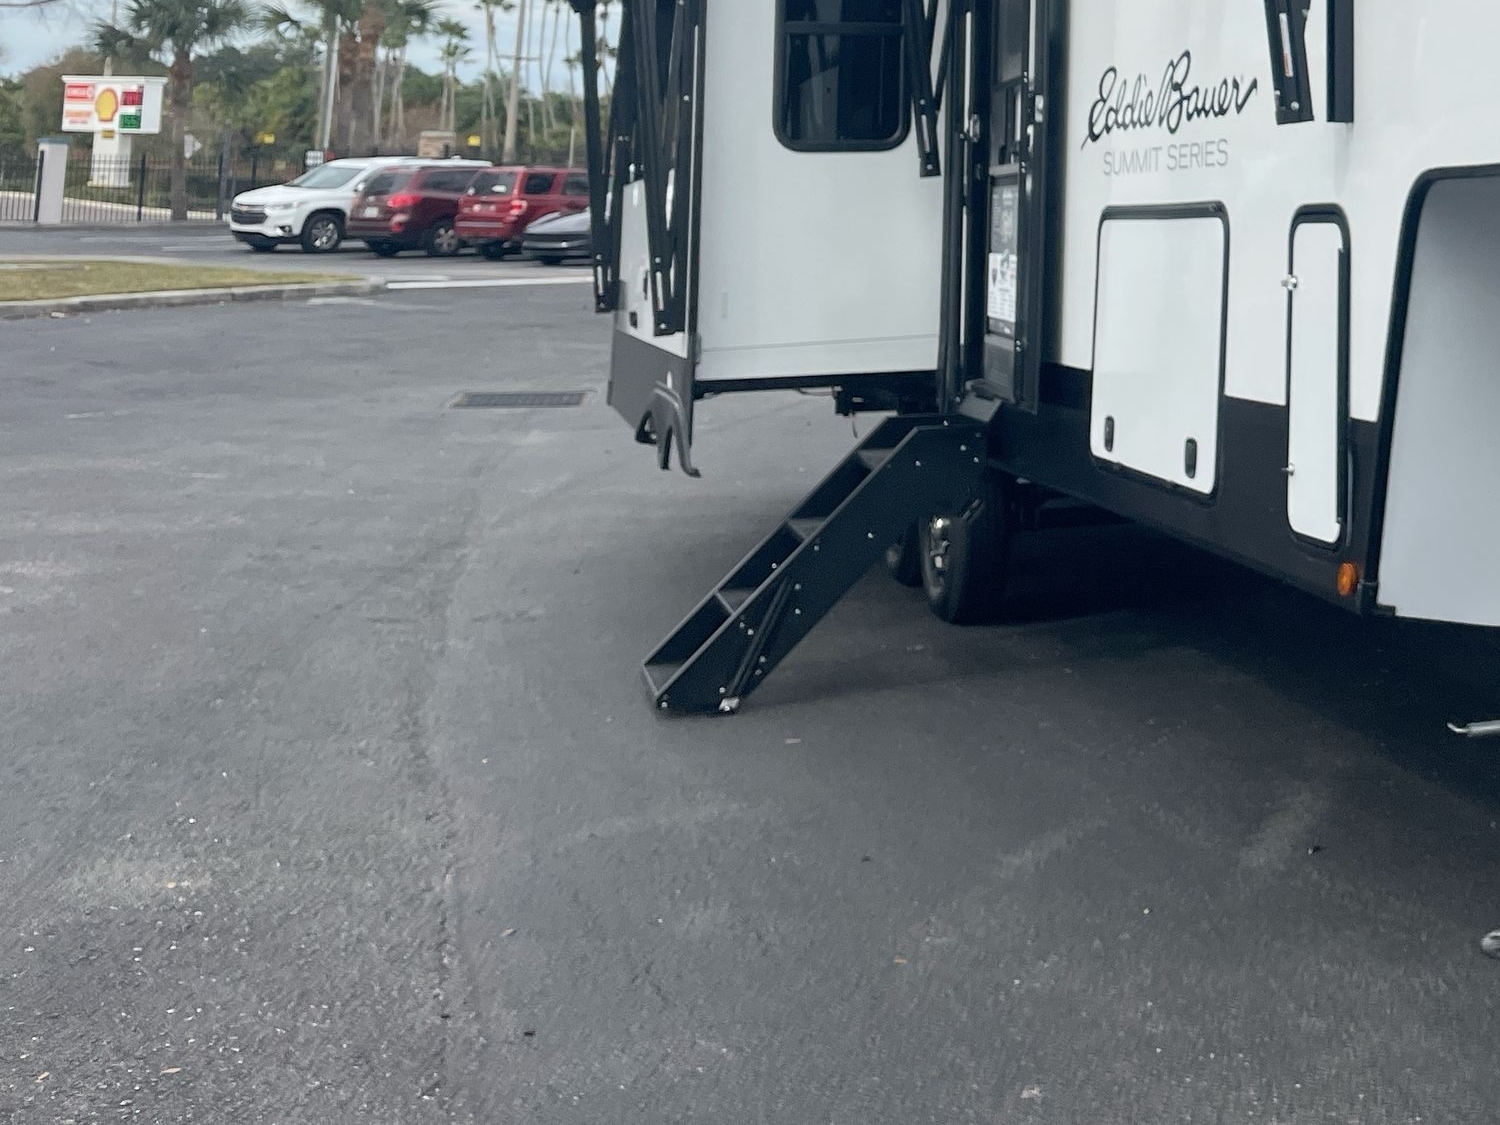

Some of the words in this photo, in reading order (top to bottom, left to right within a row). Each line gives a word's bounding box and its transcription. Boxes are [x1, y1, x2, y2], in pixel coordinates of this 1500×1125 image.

[1081, 66, 1156, 151] Eddie
[1157, 49, 1258, 135] Bauer
[1103, 147, 1162, 176] SUMMIT
[1166, 138, 1229, 171] SERIES
